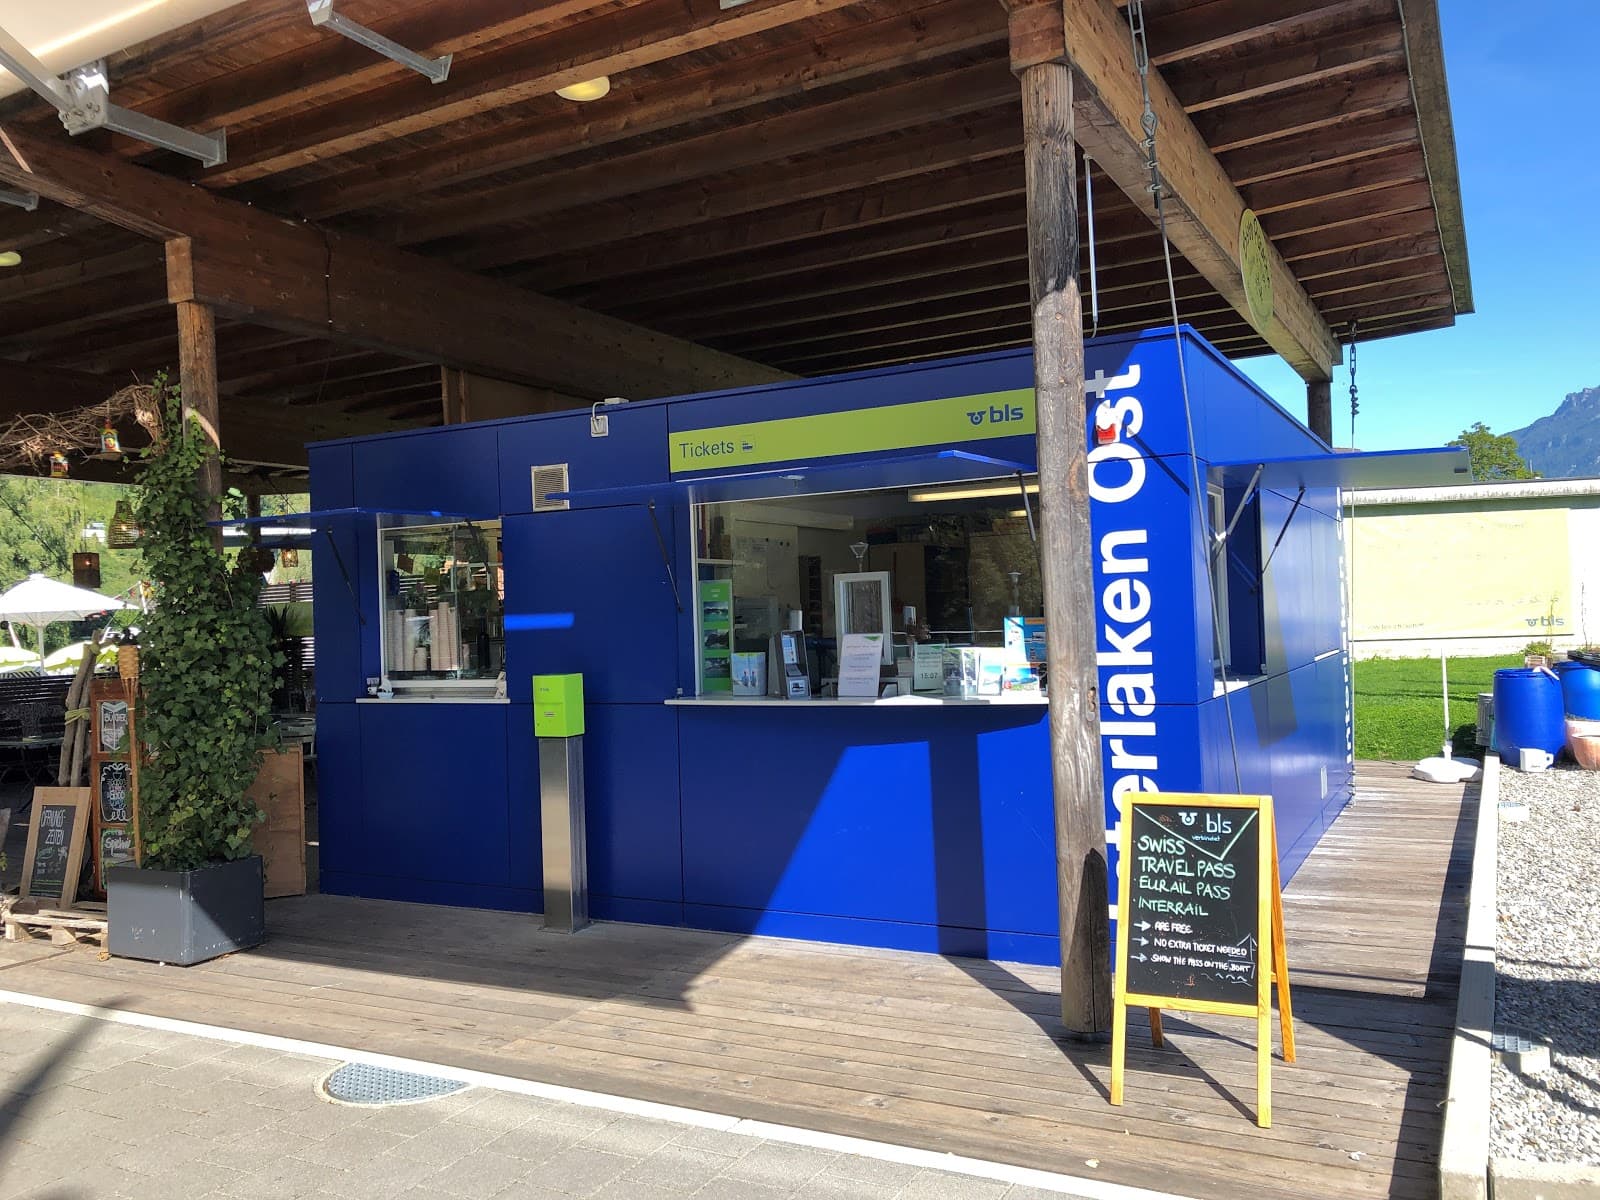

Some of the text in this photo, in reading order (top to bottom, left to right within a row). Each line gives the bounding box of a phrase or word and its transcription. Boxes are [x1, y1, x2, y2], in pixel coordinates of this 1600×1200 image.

[990, 404, 1024, 424] bls
[1085, 364, 1146, 503] Ost
[679, 441, 735, 459] Tickets
[1540, 615, 1565, 627] bls
[1206, 813, 1232, 834] bls
[1138, 856, 1236, 879] TRAVEL PASS
[1140, 875, 1231, 900] EURAIL PASS
[1138, 896, 1208, 916] INTERRAIL
[1154, 921, 1170, 932] ARE
[1153, 938, 1247, 956] NO EXTRA TICKET NEEDED
[1150, 954, 1171, 964] SHOW
[1173, 956, 1186, 966] THE
[1188, 958, 1203, 967] PASS
[1214, 961, 1229, 970] THE
[1229, 963, 1251, 973] BOAT
